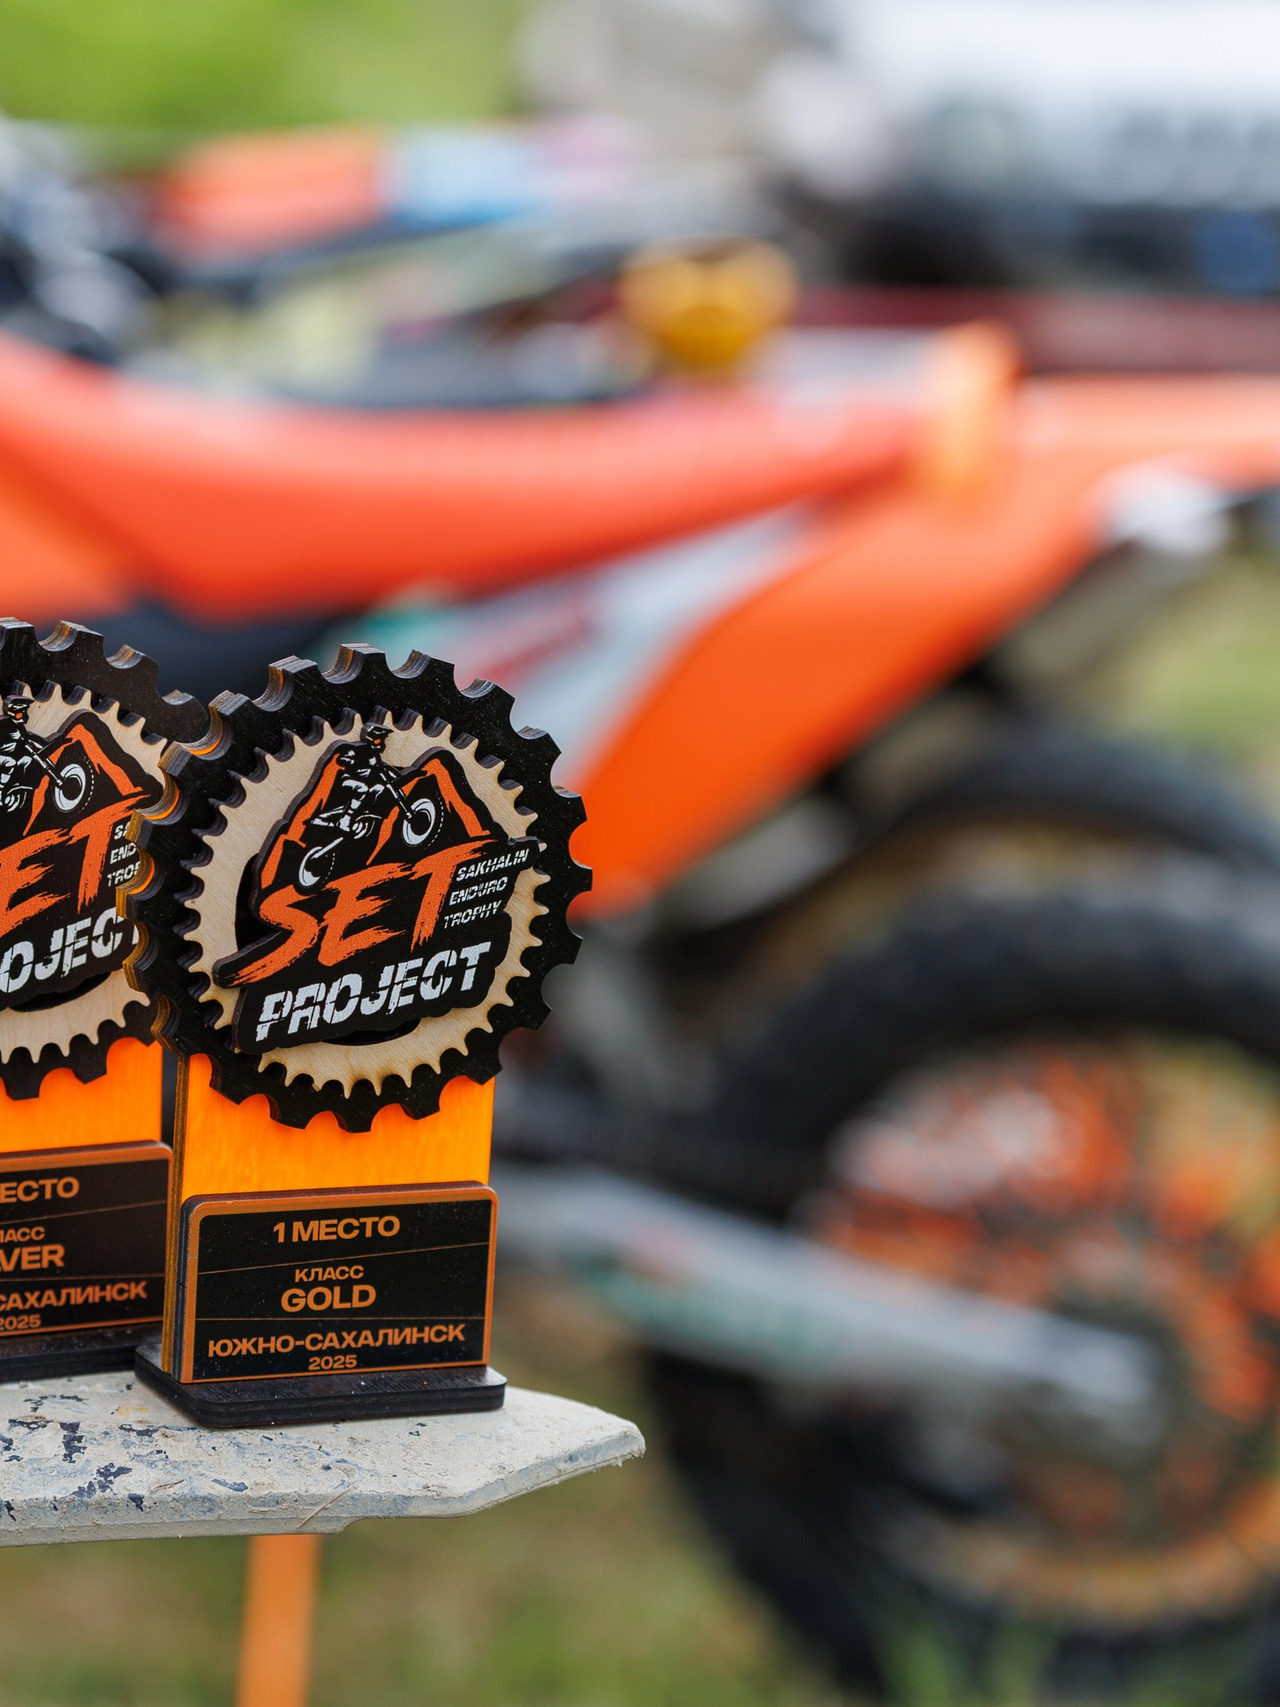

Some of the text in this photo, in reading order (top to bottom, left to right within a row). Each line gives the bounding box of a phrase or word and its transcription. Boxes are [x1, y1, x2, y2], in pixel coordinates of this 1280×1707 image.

[109, 841, 137, 864] END
[455, 848, 529, 882] SAKHALIN
[449, 876, 507, 907] ENDURO
[225, 838, 499, 988] SET
[443, 900, 502, 930] TROPHY
[255, 941, 491, 1042] PROJECT
[273, 1215, 401, 1243] 1 МЕСТО
[294, 1265, 365, 1283] КЛАСС
[280, 1284, 377, 1313] GOLD
[208, 1323, 467, 1358] ЮЖНО-САХАЛИНСК
[308, 1354, 358, 1371] 2025
